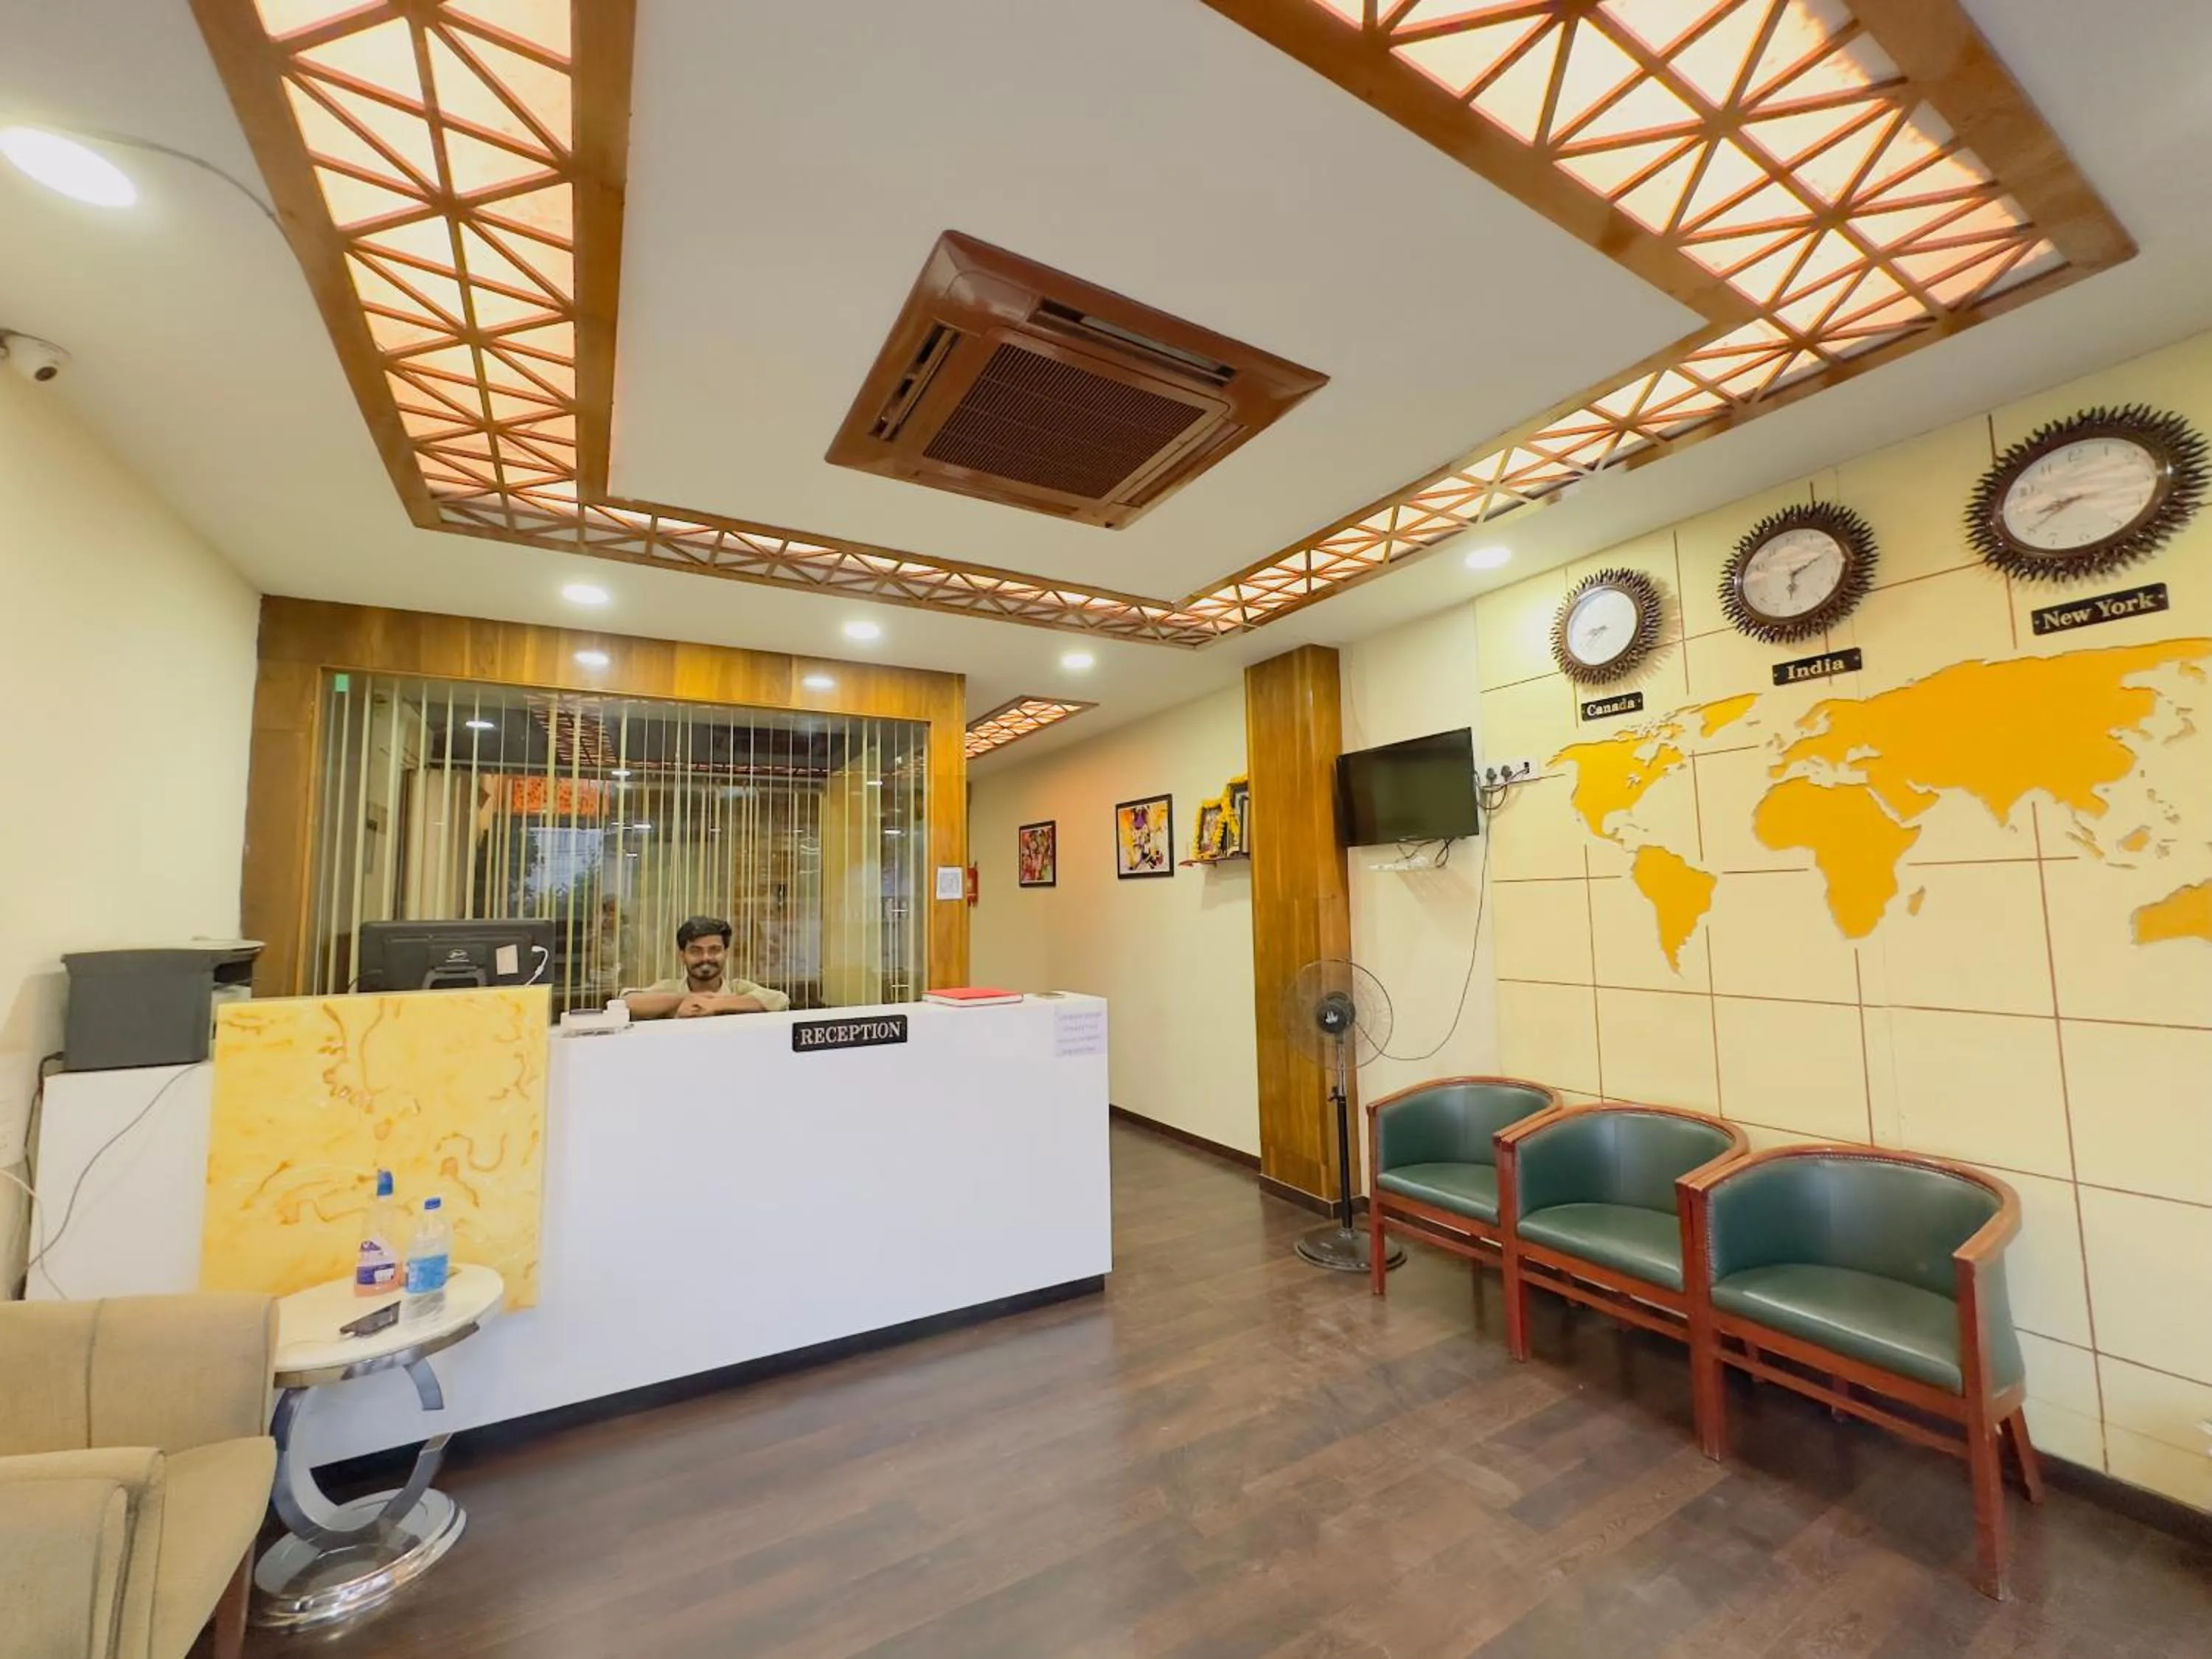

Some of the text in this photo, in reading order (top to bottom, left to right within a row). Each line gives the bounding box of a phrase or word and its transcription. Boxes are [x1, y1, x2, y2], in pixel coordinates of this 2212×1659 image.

[2042, 592, 2157, 629] New York
[1787, 658, 1844, 679] India
[1587, 697, 1635, 716] Canada
[800, 1021, 902, 1046] RECEPTION
